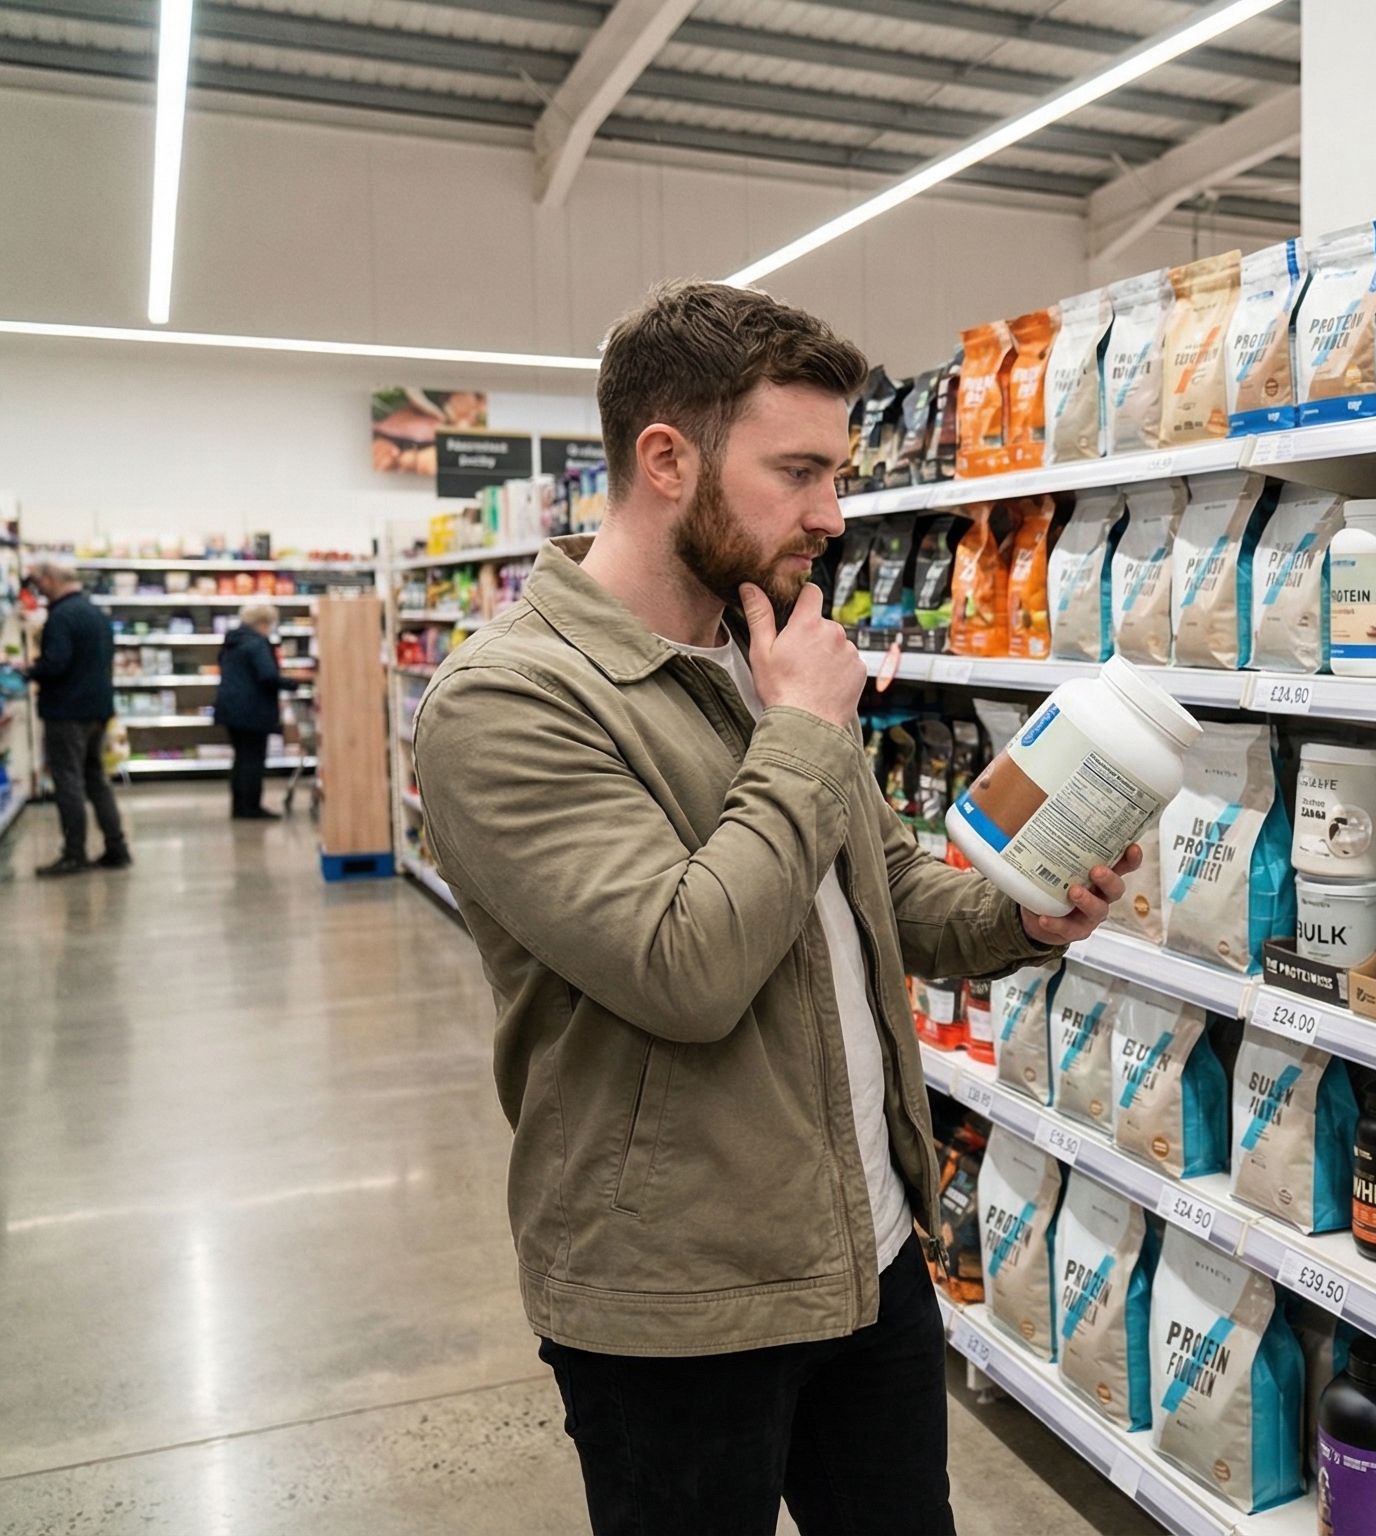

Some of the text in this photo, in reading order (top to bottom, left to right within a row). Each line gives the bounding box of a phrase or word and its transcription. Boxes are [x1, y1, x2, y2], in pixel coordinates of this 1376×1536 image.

[1331, 590, 1370, 602] ROTEIN
[1173, 835, 1236, 863] PROTEIN
[1273, 1006, 1315, 1034] £24.00
[1298, 1268, 1344, 1302] £39.50
